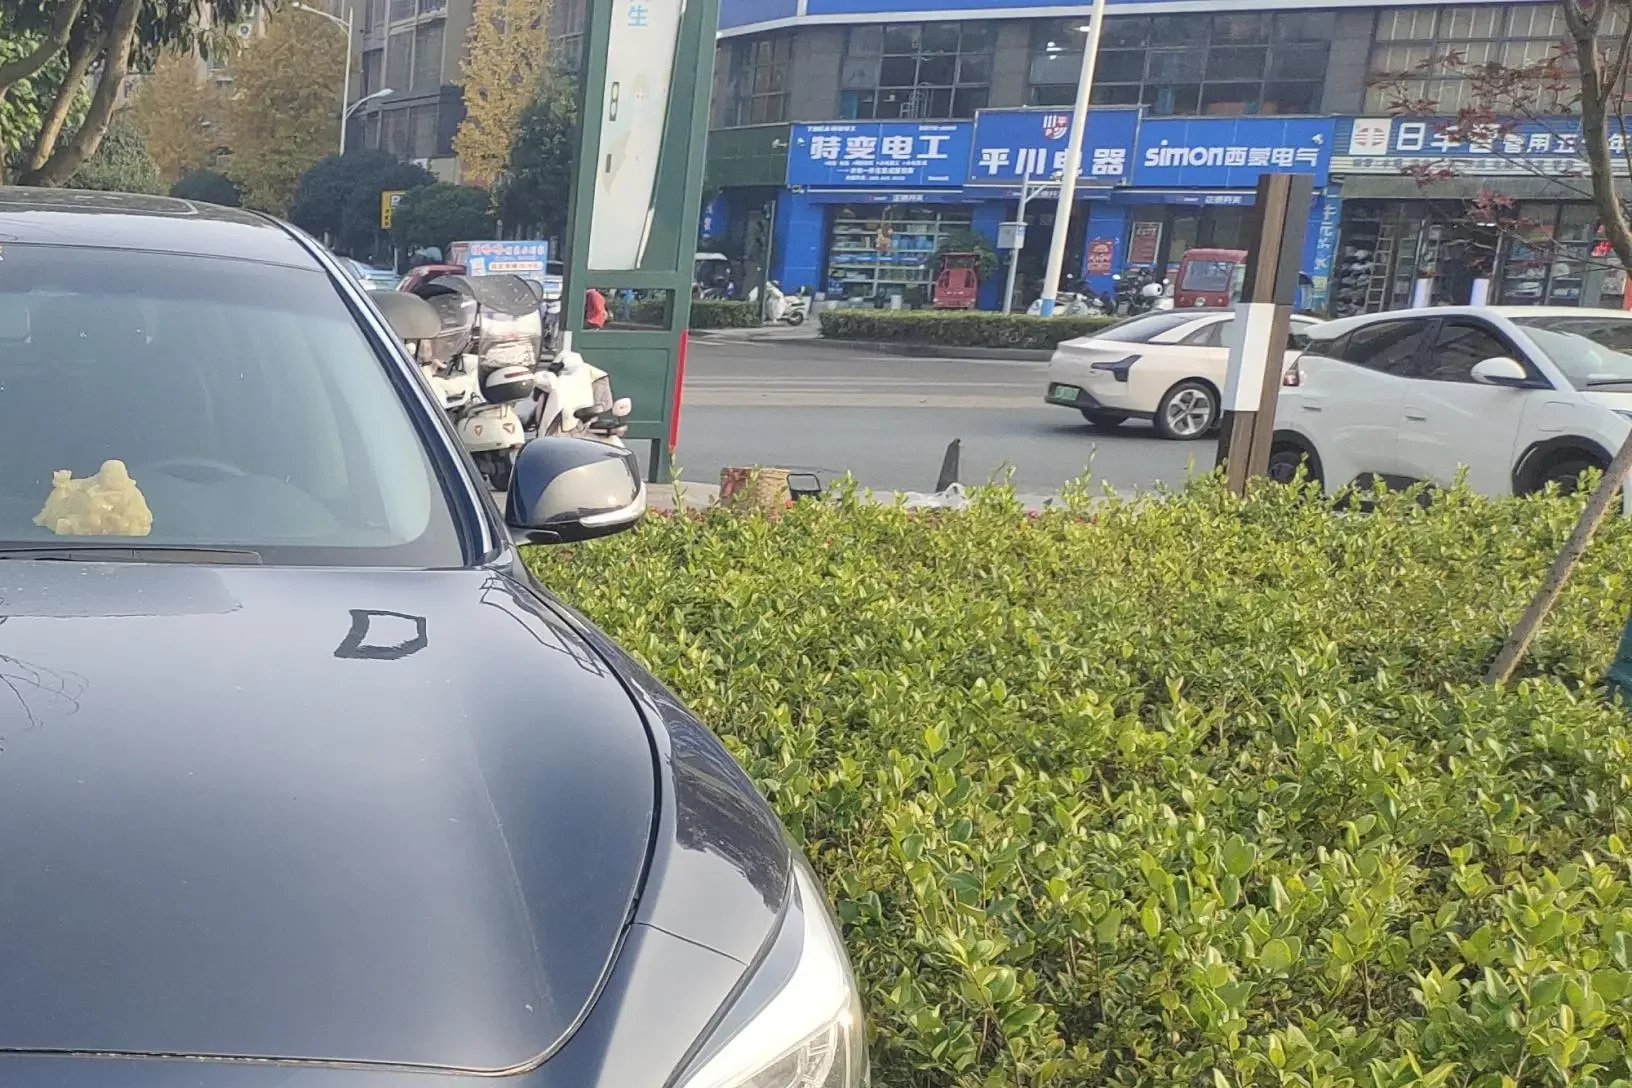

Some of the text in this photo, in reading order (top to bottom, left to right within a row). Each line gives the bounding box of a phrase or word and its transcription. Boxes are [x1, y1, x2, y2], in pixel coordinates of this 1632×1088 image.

[810, 136, 951, 160] 特变电工
[1502, 133, 1631, 153] 管用五年
